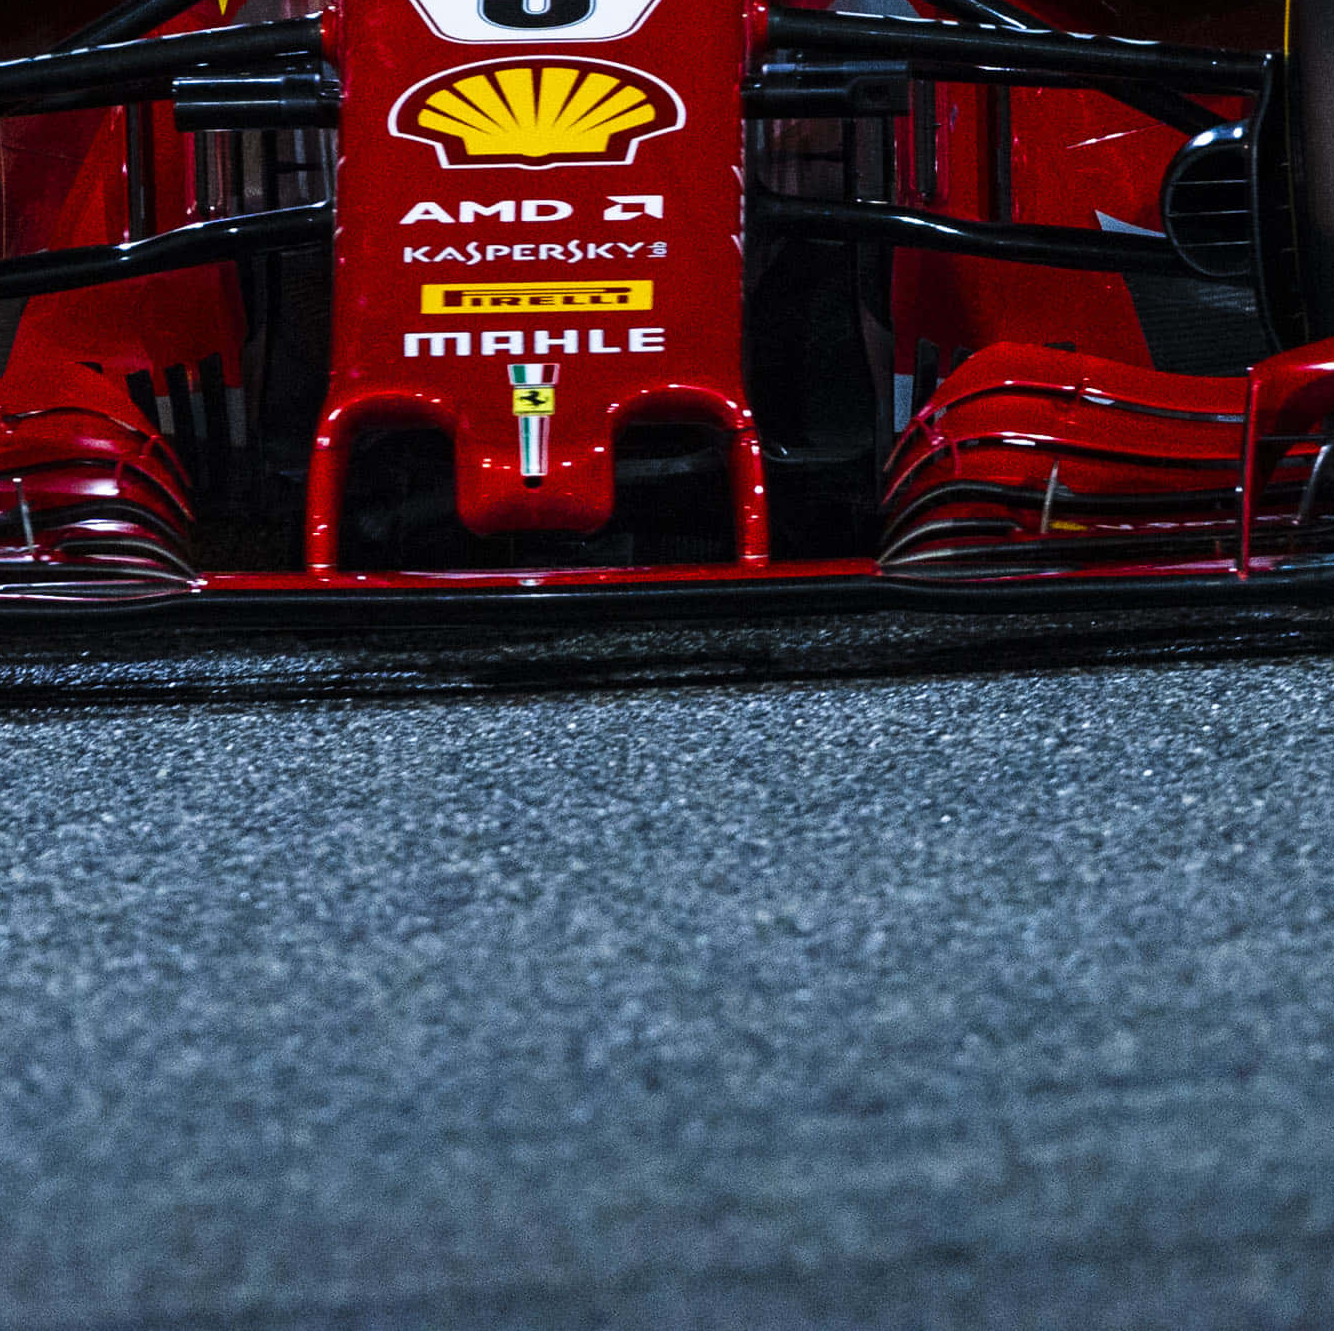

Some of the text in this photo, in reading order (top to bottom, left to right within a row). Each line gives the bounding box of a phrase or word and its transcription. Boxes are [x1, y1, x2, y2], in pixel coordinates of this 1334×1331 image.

[399, 199, 574, 225] AMD
[403, 239, 645, 265] KASPERSKY
[443, 286, 633, 308] PIRELLI
[404, 327, 666, 357] MAHLE
